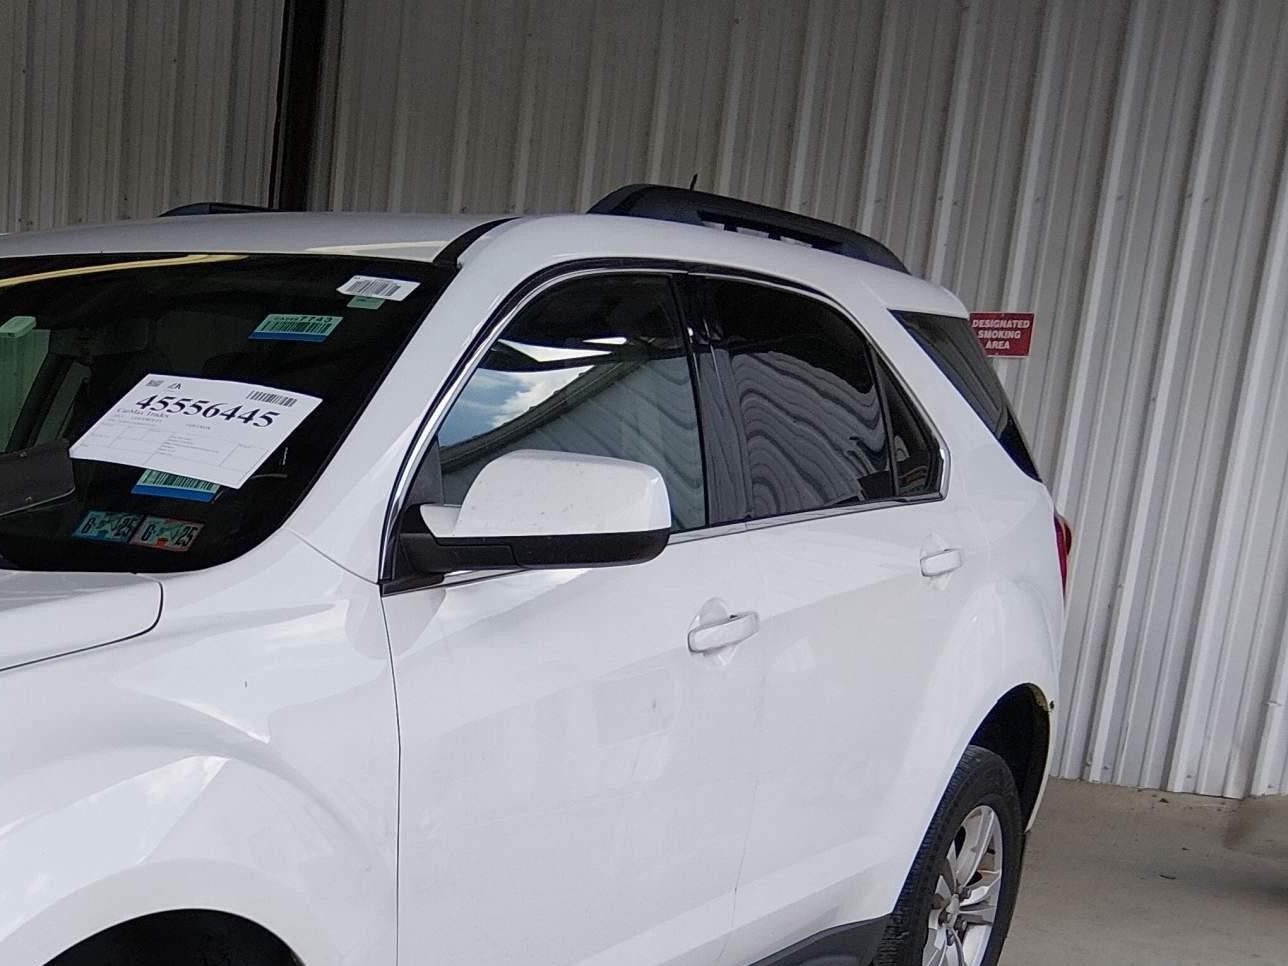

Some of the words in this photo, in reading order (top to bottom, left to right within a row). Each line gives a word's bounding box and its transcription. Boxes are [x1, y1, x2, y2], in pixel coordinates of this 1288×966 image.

[972, 319, 1030, 329] DESIGNATED
[977, 329, 1021, 339] SMOKING
[985, 340, 1010, 350] AREA
[135, 394, 281, 428] 45556445
[175, 526, 198, 545] 25
